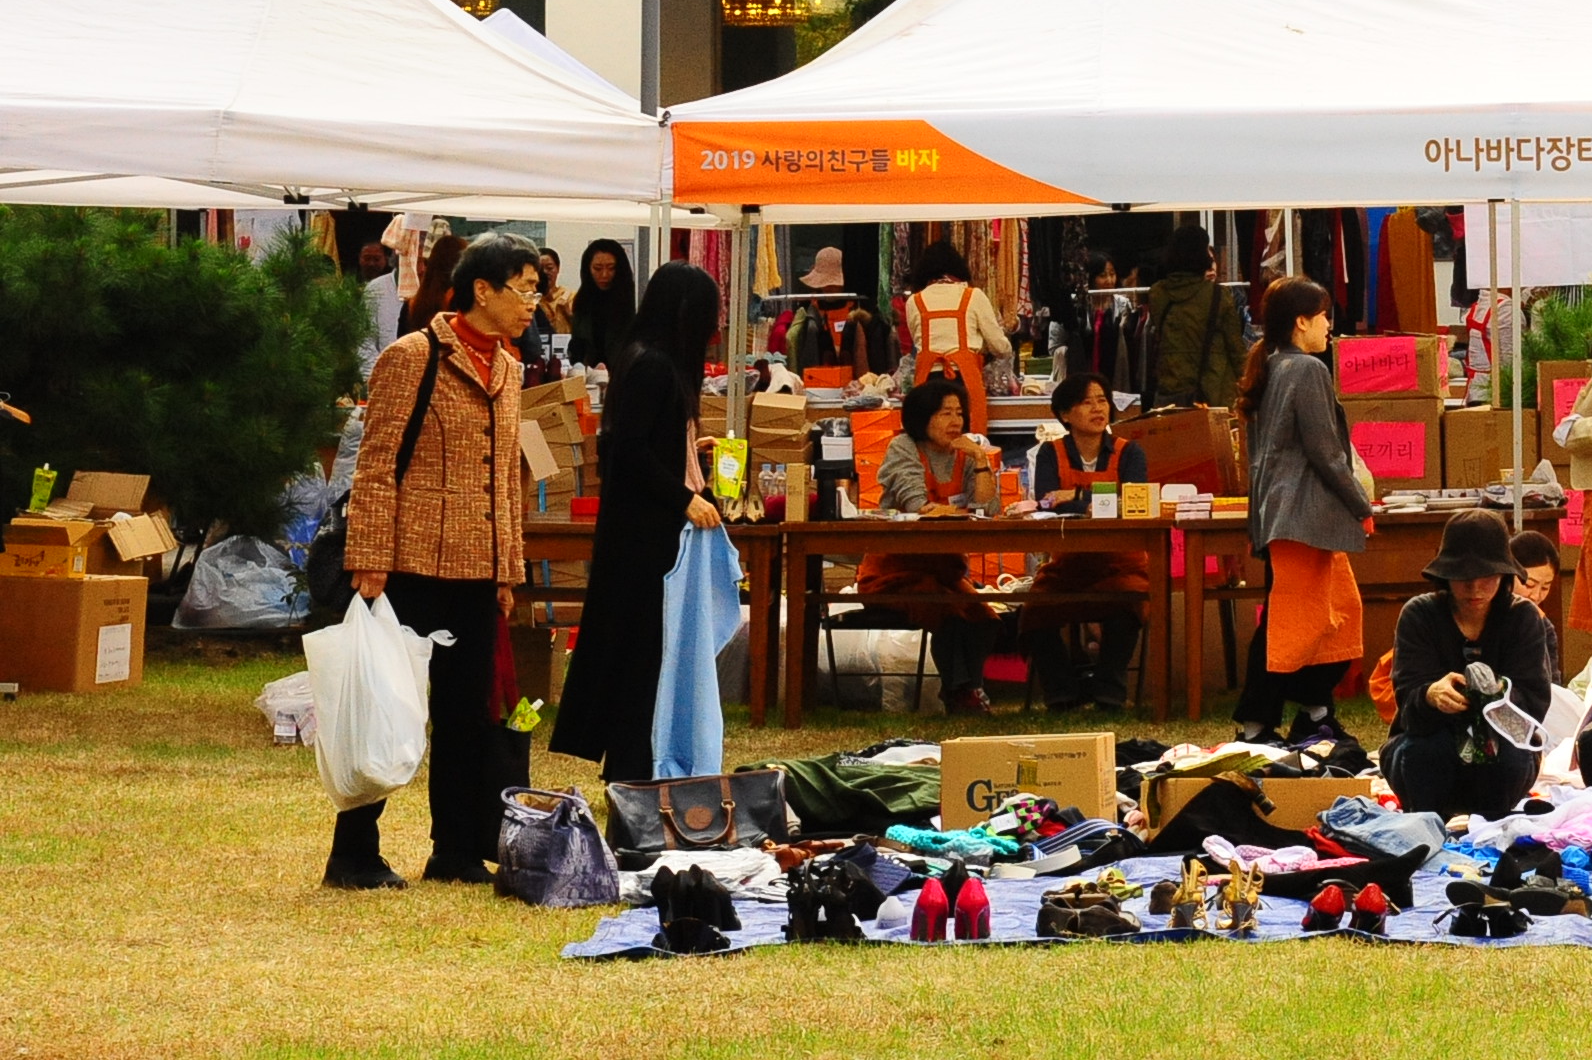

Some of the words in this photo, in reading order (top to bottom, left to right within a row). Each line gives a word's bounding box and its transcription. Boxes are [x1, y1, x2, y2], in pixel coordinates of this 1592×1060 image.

[700, 149, 756, 170] 2019
[761, 148, 891, 173] 사랑의친구들
[896, 148, 940, 173] 바자
[1344, 353, 1410, 374] 아나바다
[1359, 441, 1413, 461] 코끼리
